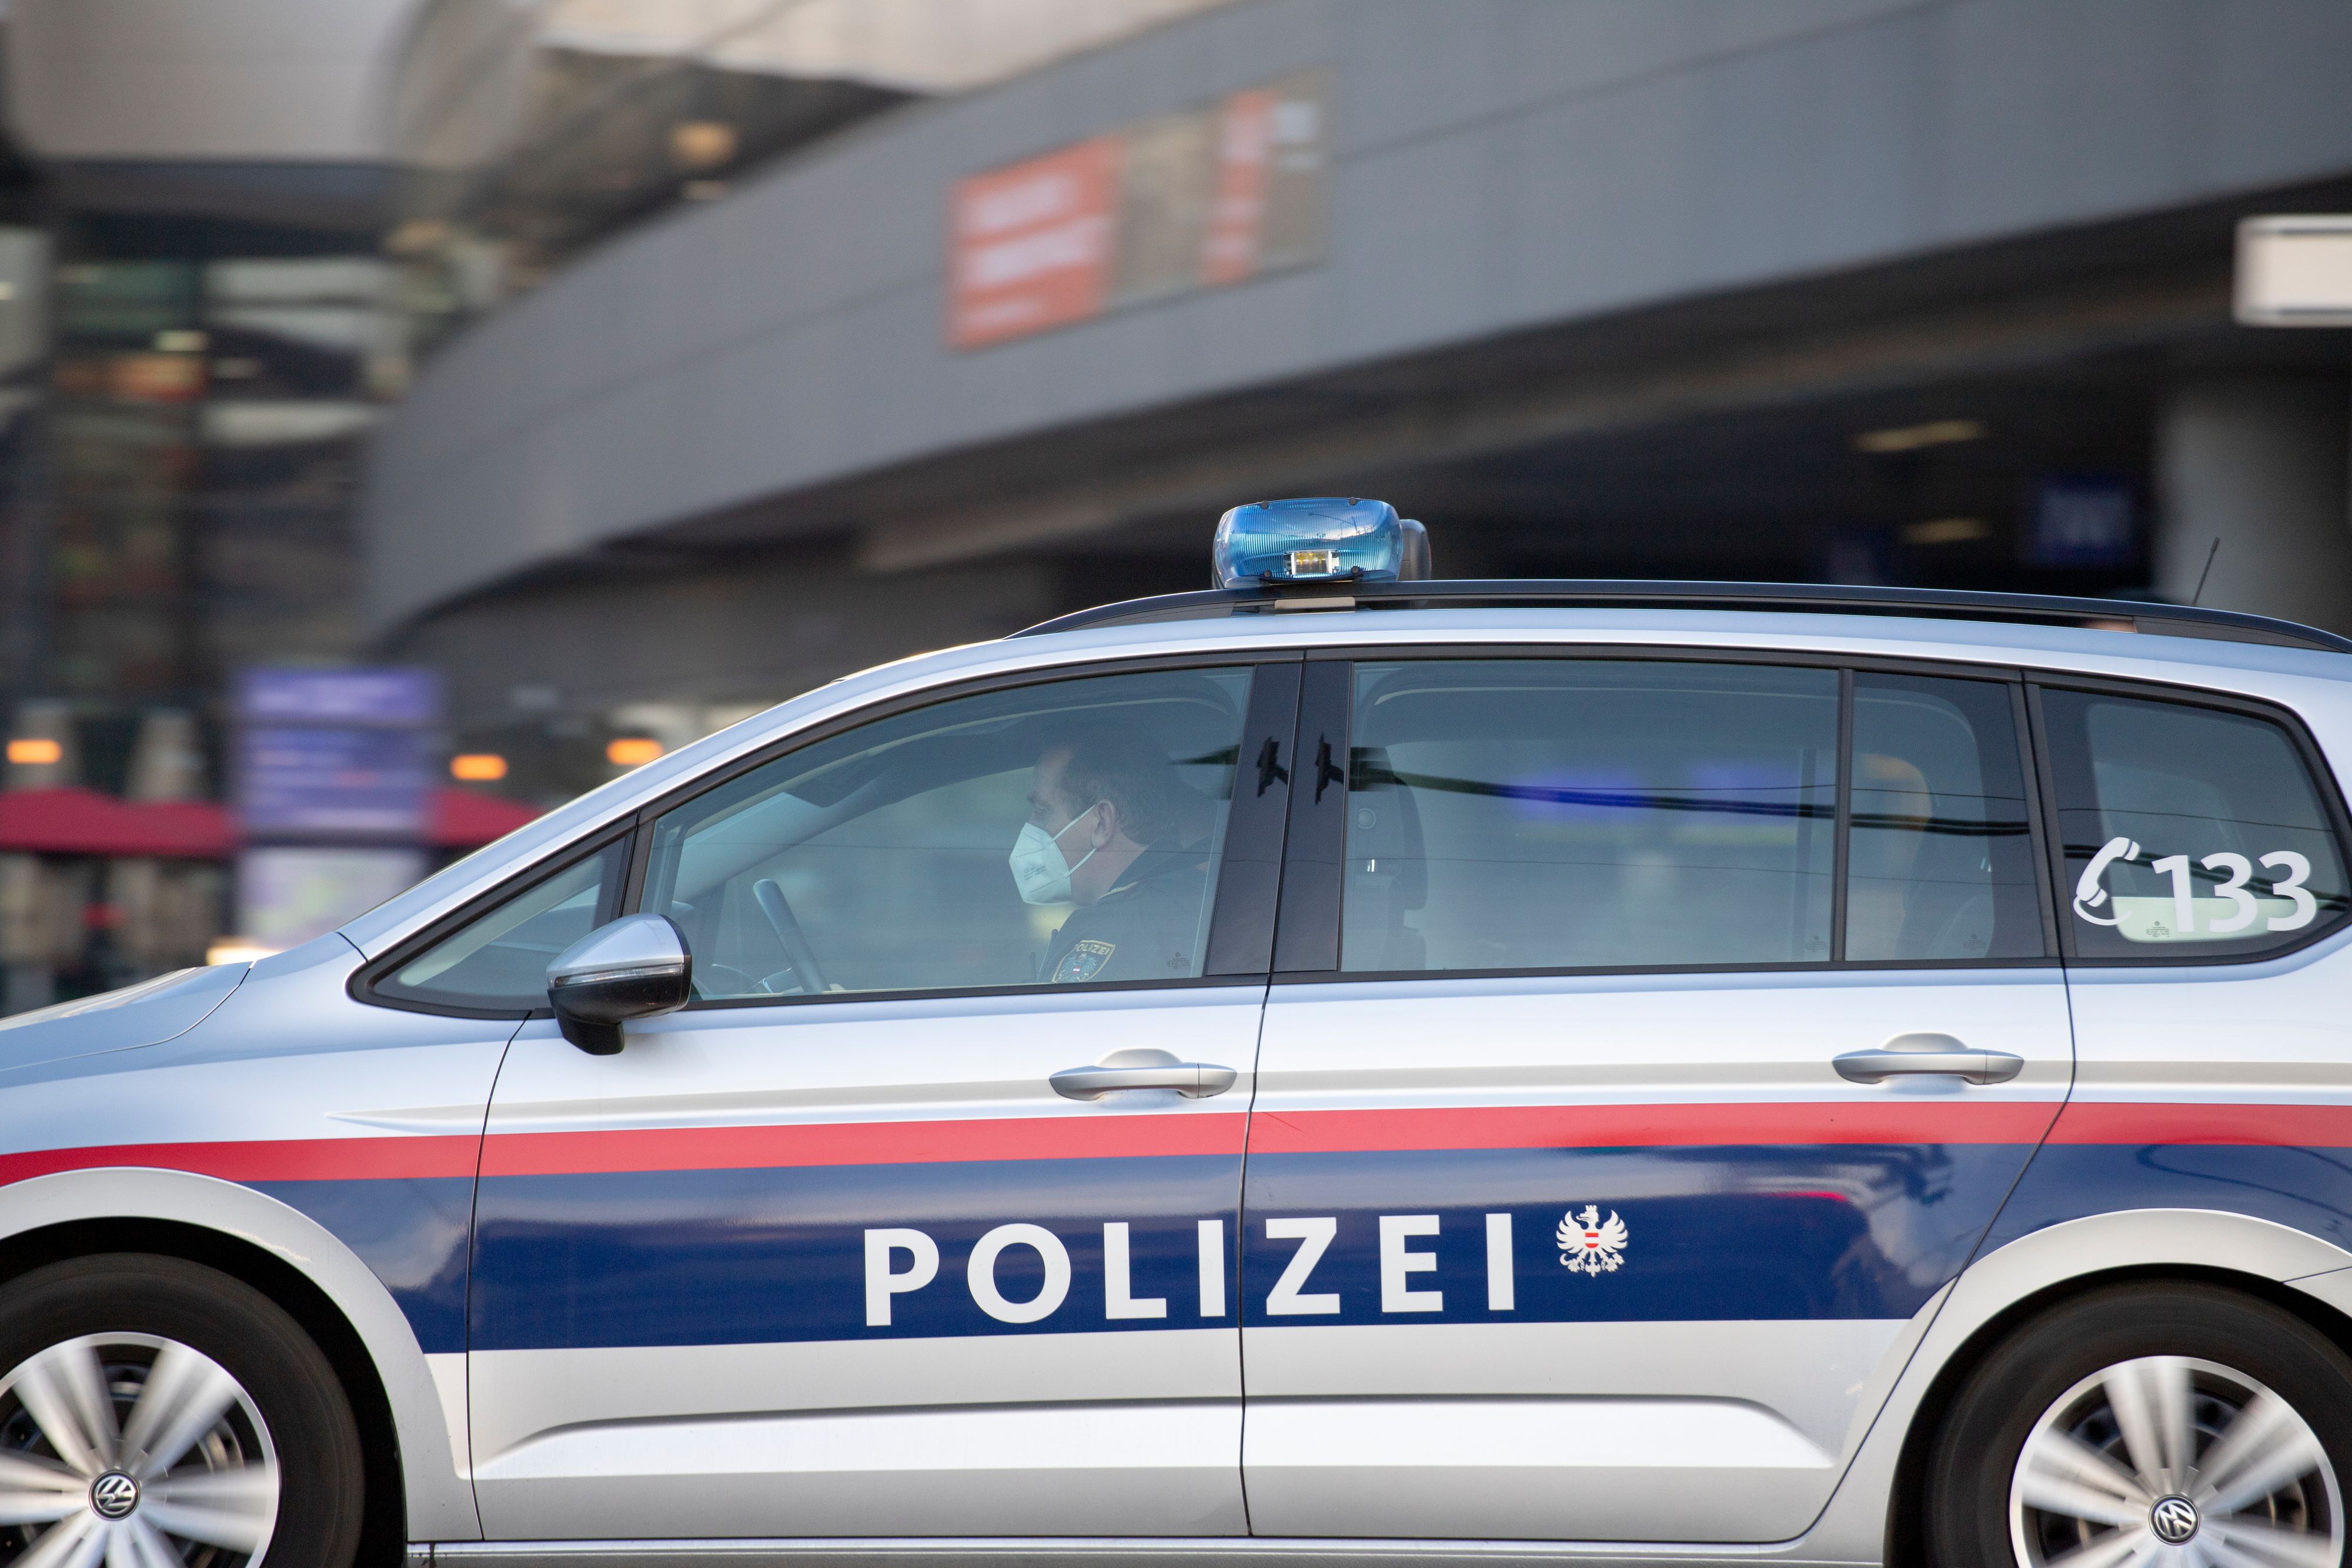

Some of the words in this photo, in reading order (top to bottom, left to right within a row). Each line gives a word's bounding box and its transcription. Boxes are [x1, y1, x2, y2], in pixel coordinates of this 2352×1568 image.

[2151, 850, 2317, 934] 133
[1077, 943, 1111, 955] OLIZEI
[864, 1213, 1514, 1326] POLIZEI
[2154, 1499, 2196, 1539] VW
